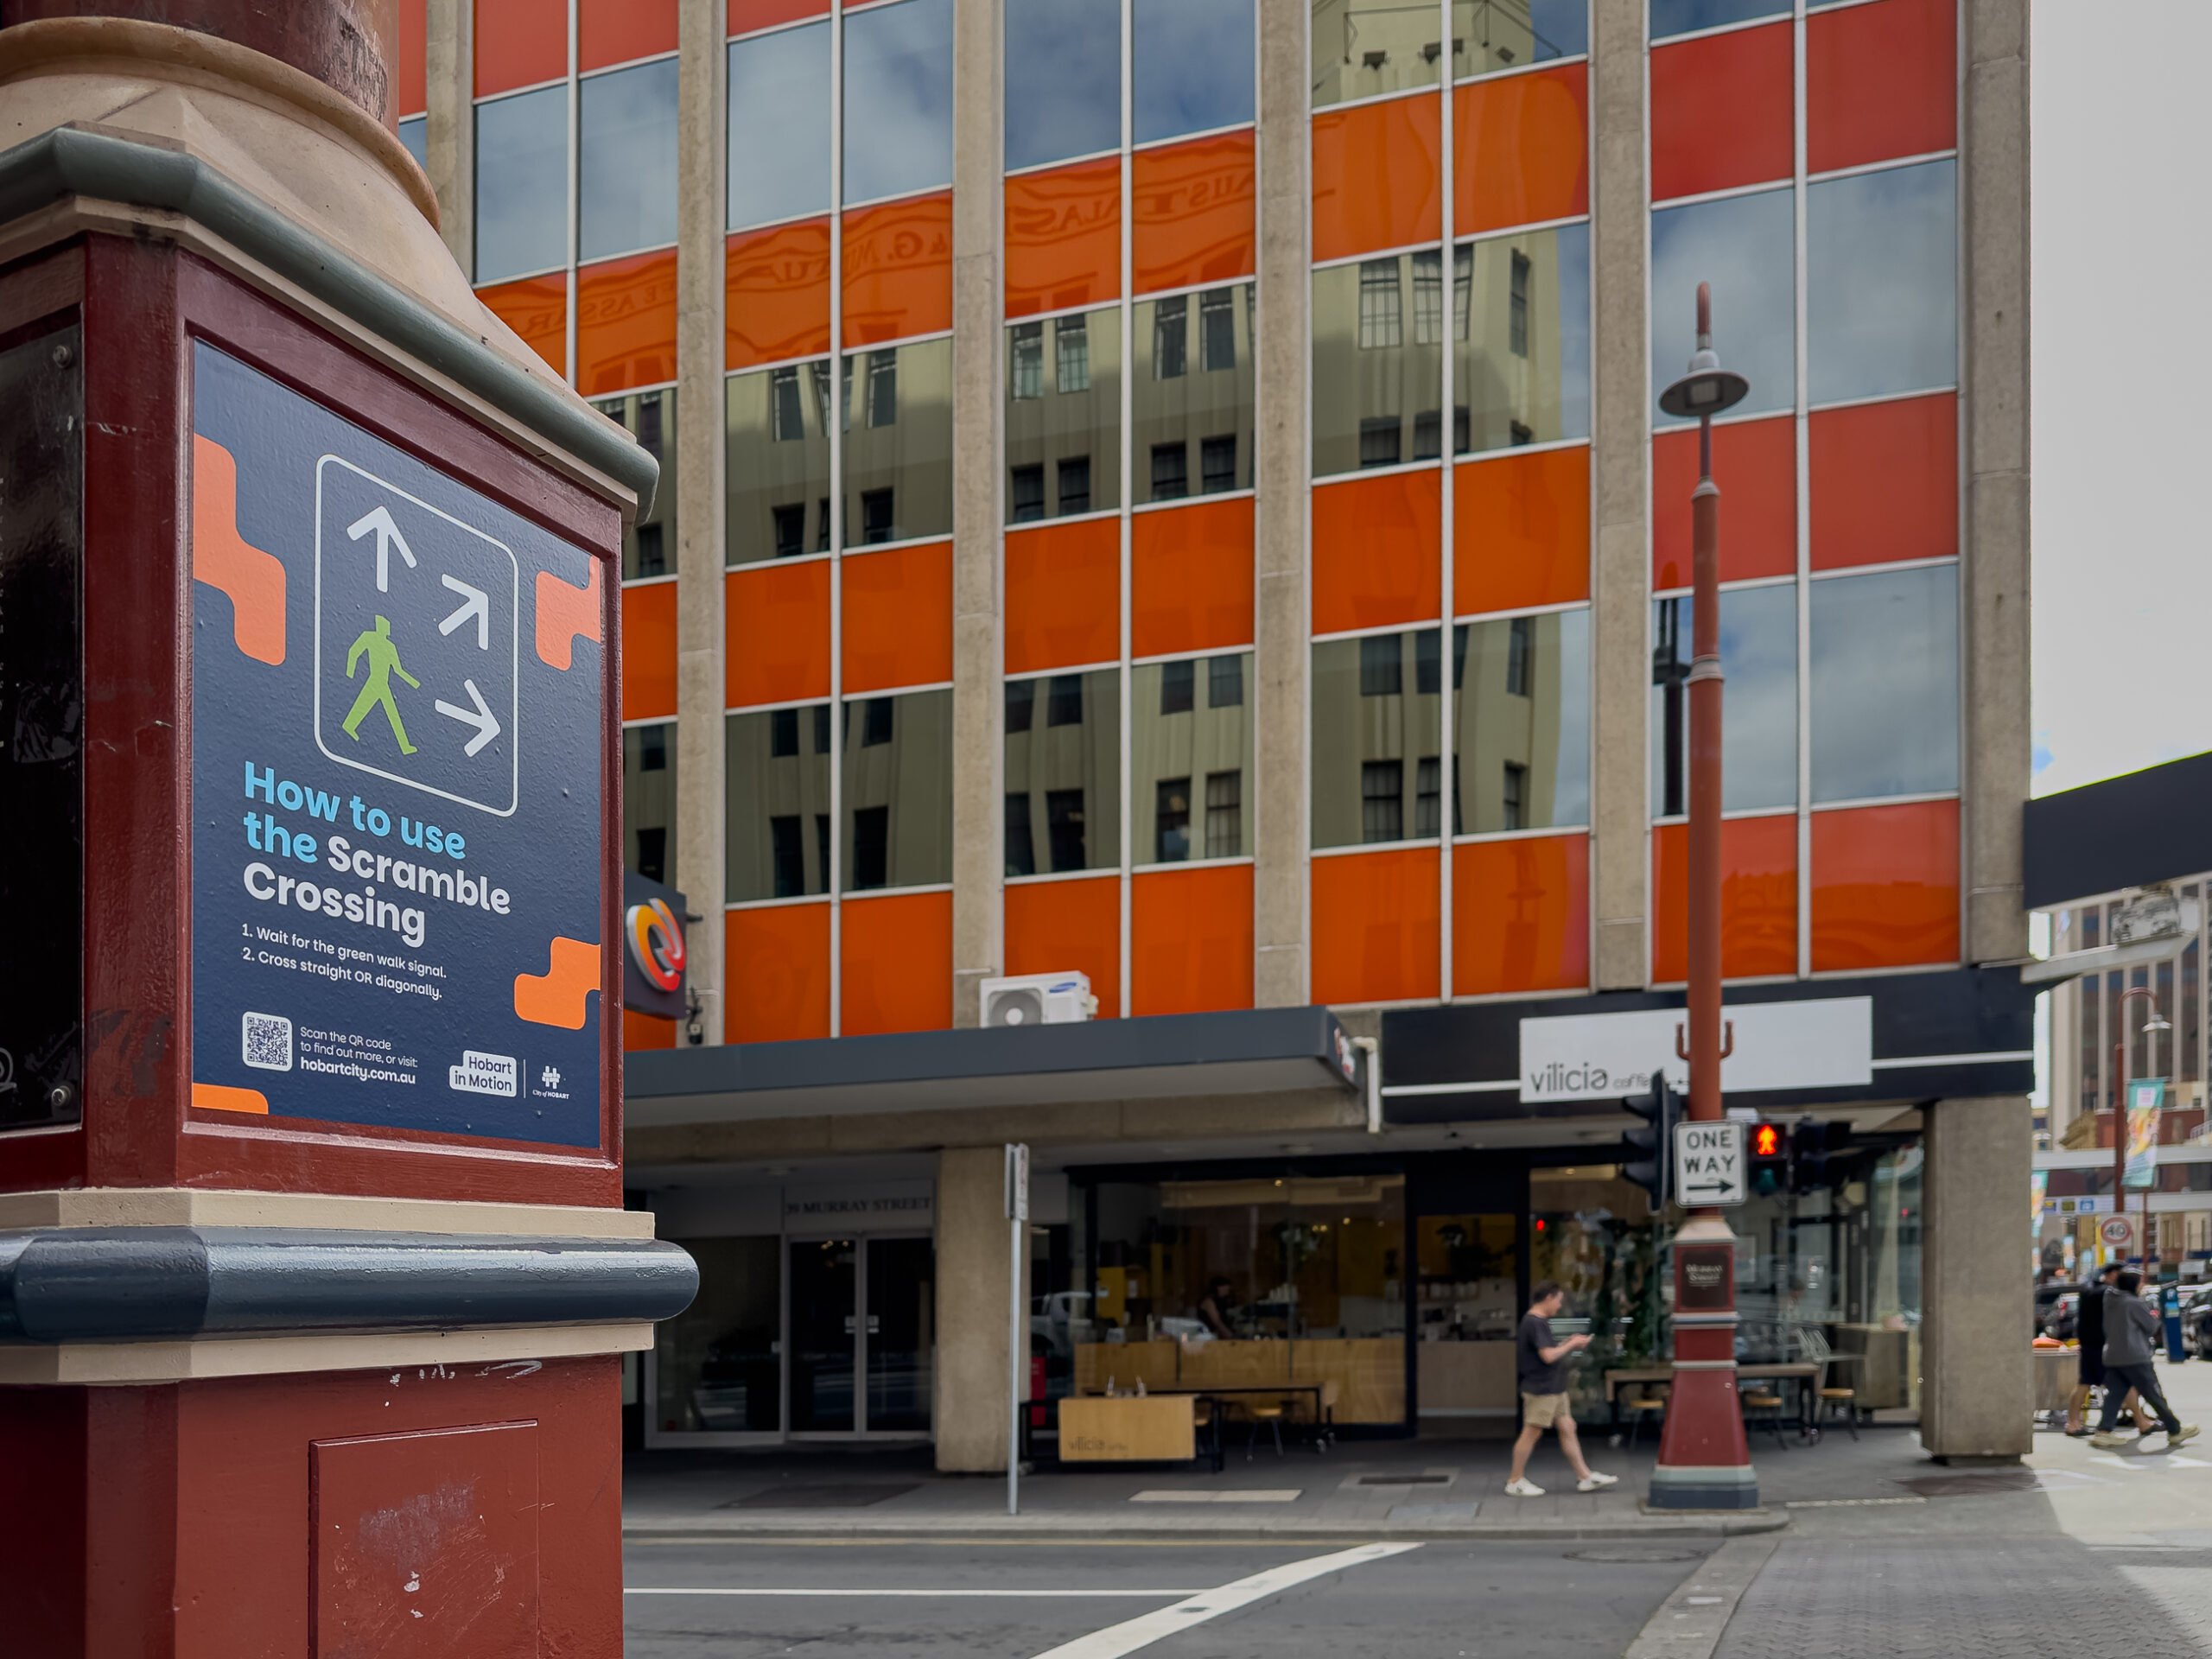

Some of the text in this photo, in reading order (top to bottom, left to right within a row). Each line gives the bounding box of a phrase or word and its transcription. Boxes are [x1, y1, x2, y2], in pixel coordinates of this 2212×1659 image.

[245, 760, 466, 860] How to use
[244, 811, 511, 915] the Scramble
[244, 862, 425, 948] Crossing
[242, 923, 447, 978] 1. Wait for the green walk signal.
[243, 947, 442, 1001] 2. Cross straight OR diagonally.
[301, 1027, 391, 1051] Scan the QR code
[301, 1041, 311, 1052] to
[314, 1043, 334, 1056] find
[336, 1046, 353, 1058] out
[355, 1050, 385, 1064] more,
[385, 1053, 396, 1064] or
[301, 1056, 416, 1084] hobartcity.com.au
[468, 1055, 512, 1075] Hobart
[454, 1070, 512, 1091] in Motion
[1612, 1072, 1651, 1090] coffe
[548, 1091, 570, 1100] HOBART
[1687, 1129, 1732, 1150] ONE
[1684, 1154, 1736, 1174] WAY
[803, 1198, 868, 1214] MURRAY
[872, 1196, 931, 1211] STREET
